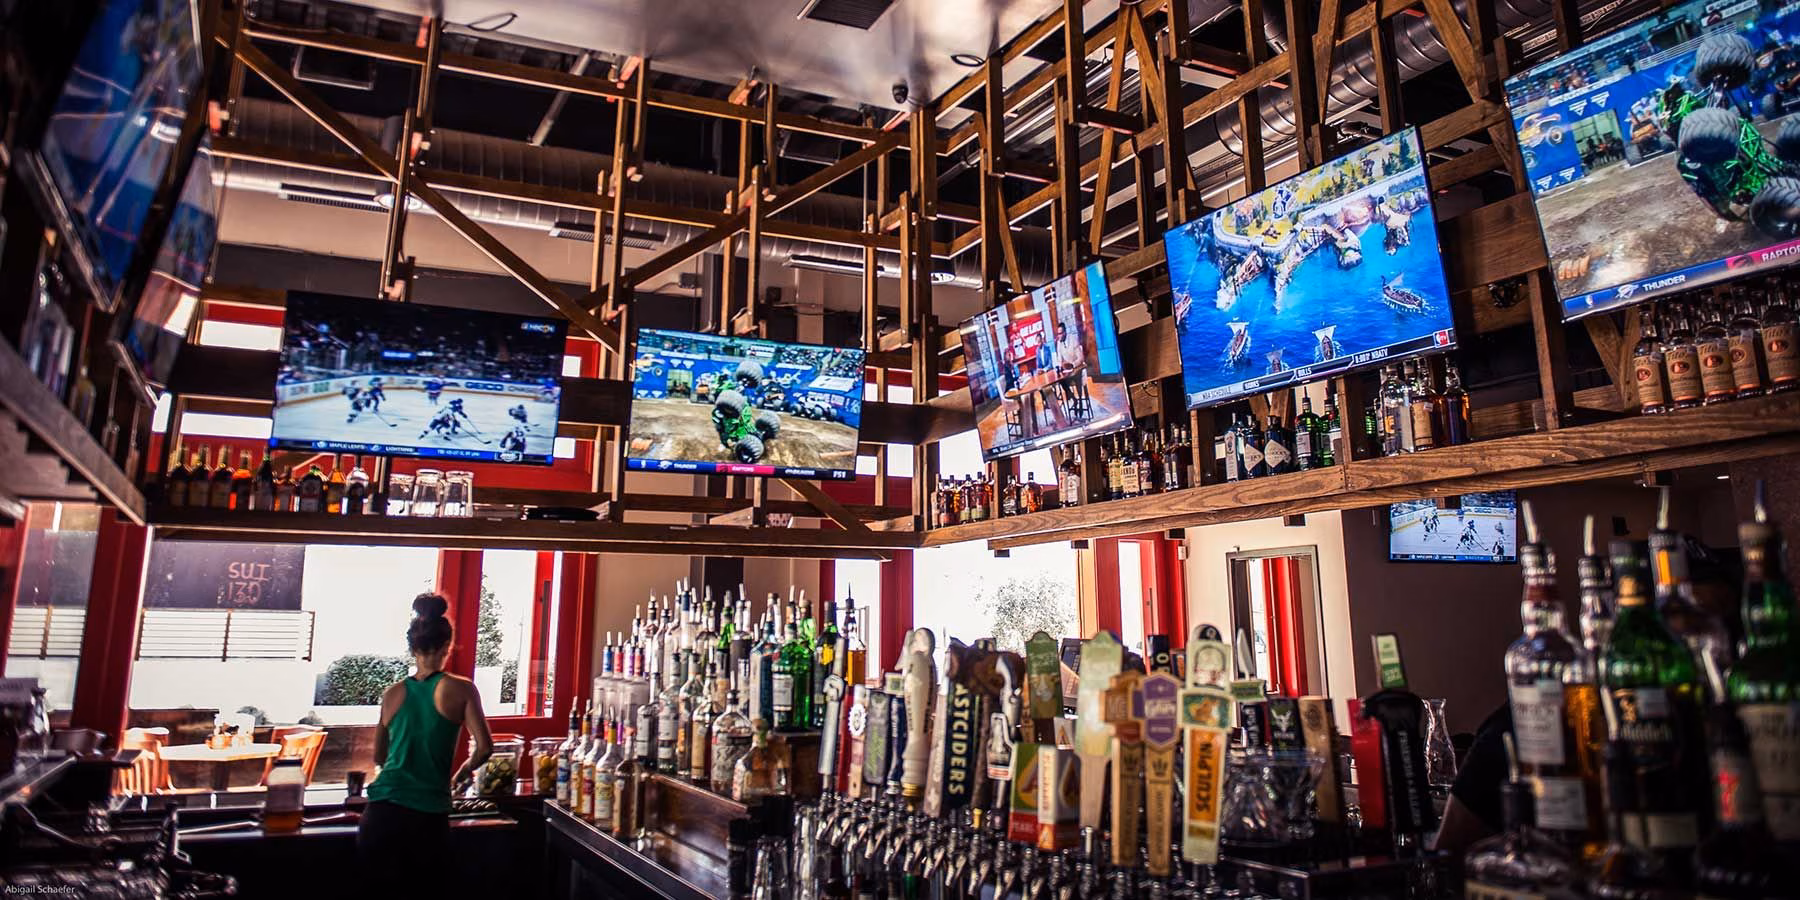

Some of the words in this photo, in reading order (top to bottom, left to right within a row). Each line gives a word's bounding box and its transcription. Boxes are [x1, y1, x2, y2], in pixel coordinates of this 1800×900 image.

[1642, 274, 1686, 292] THUNDER
[465, 382, 504, 391] GEICO
[1211, 386, 1231, 398] SCHEDULE
[1195, 741, 1213, 813] SCULPIN
